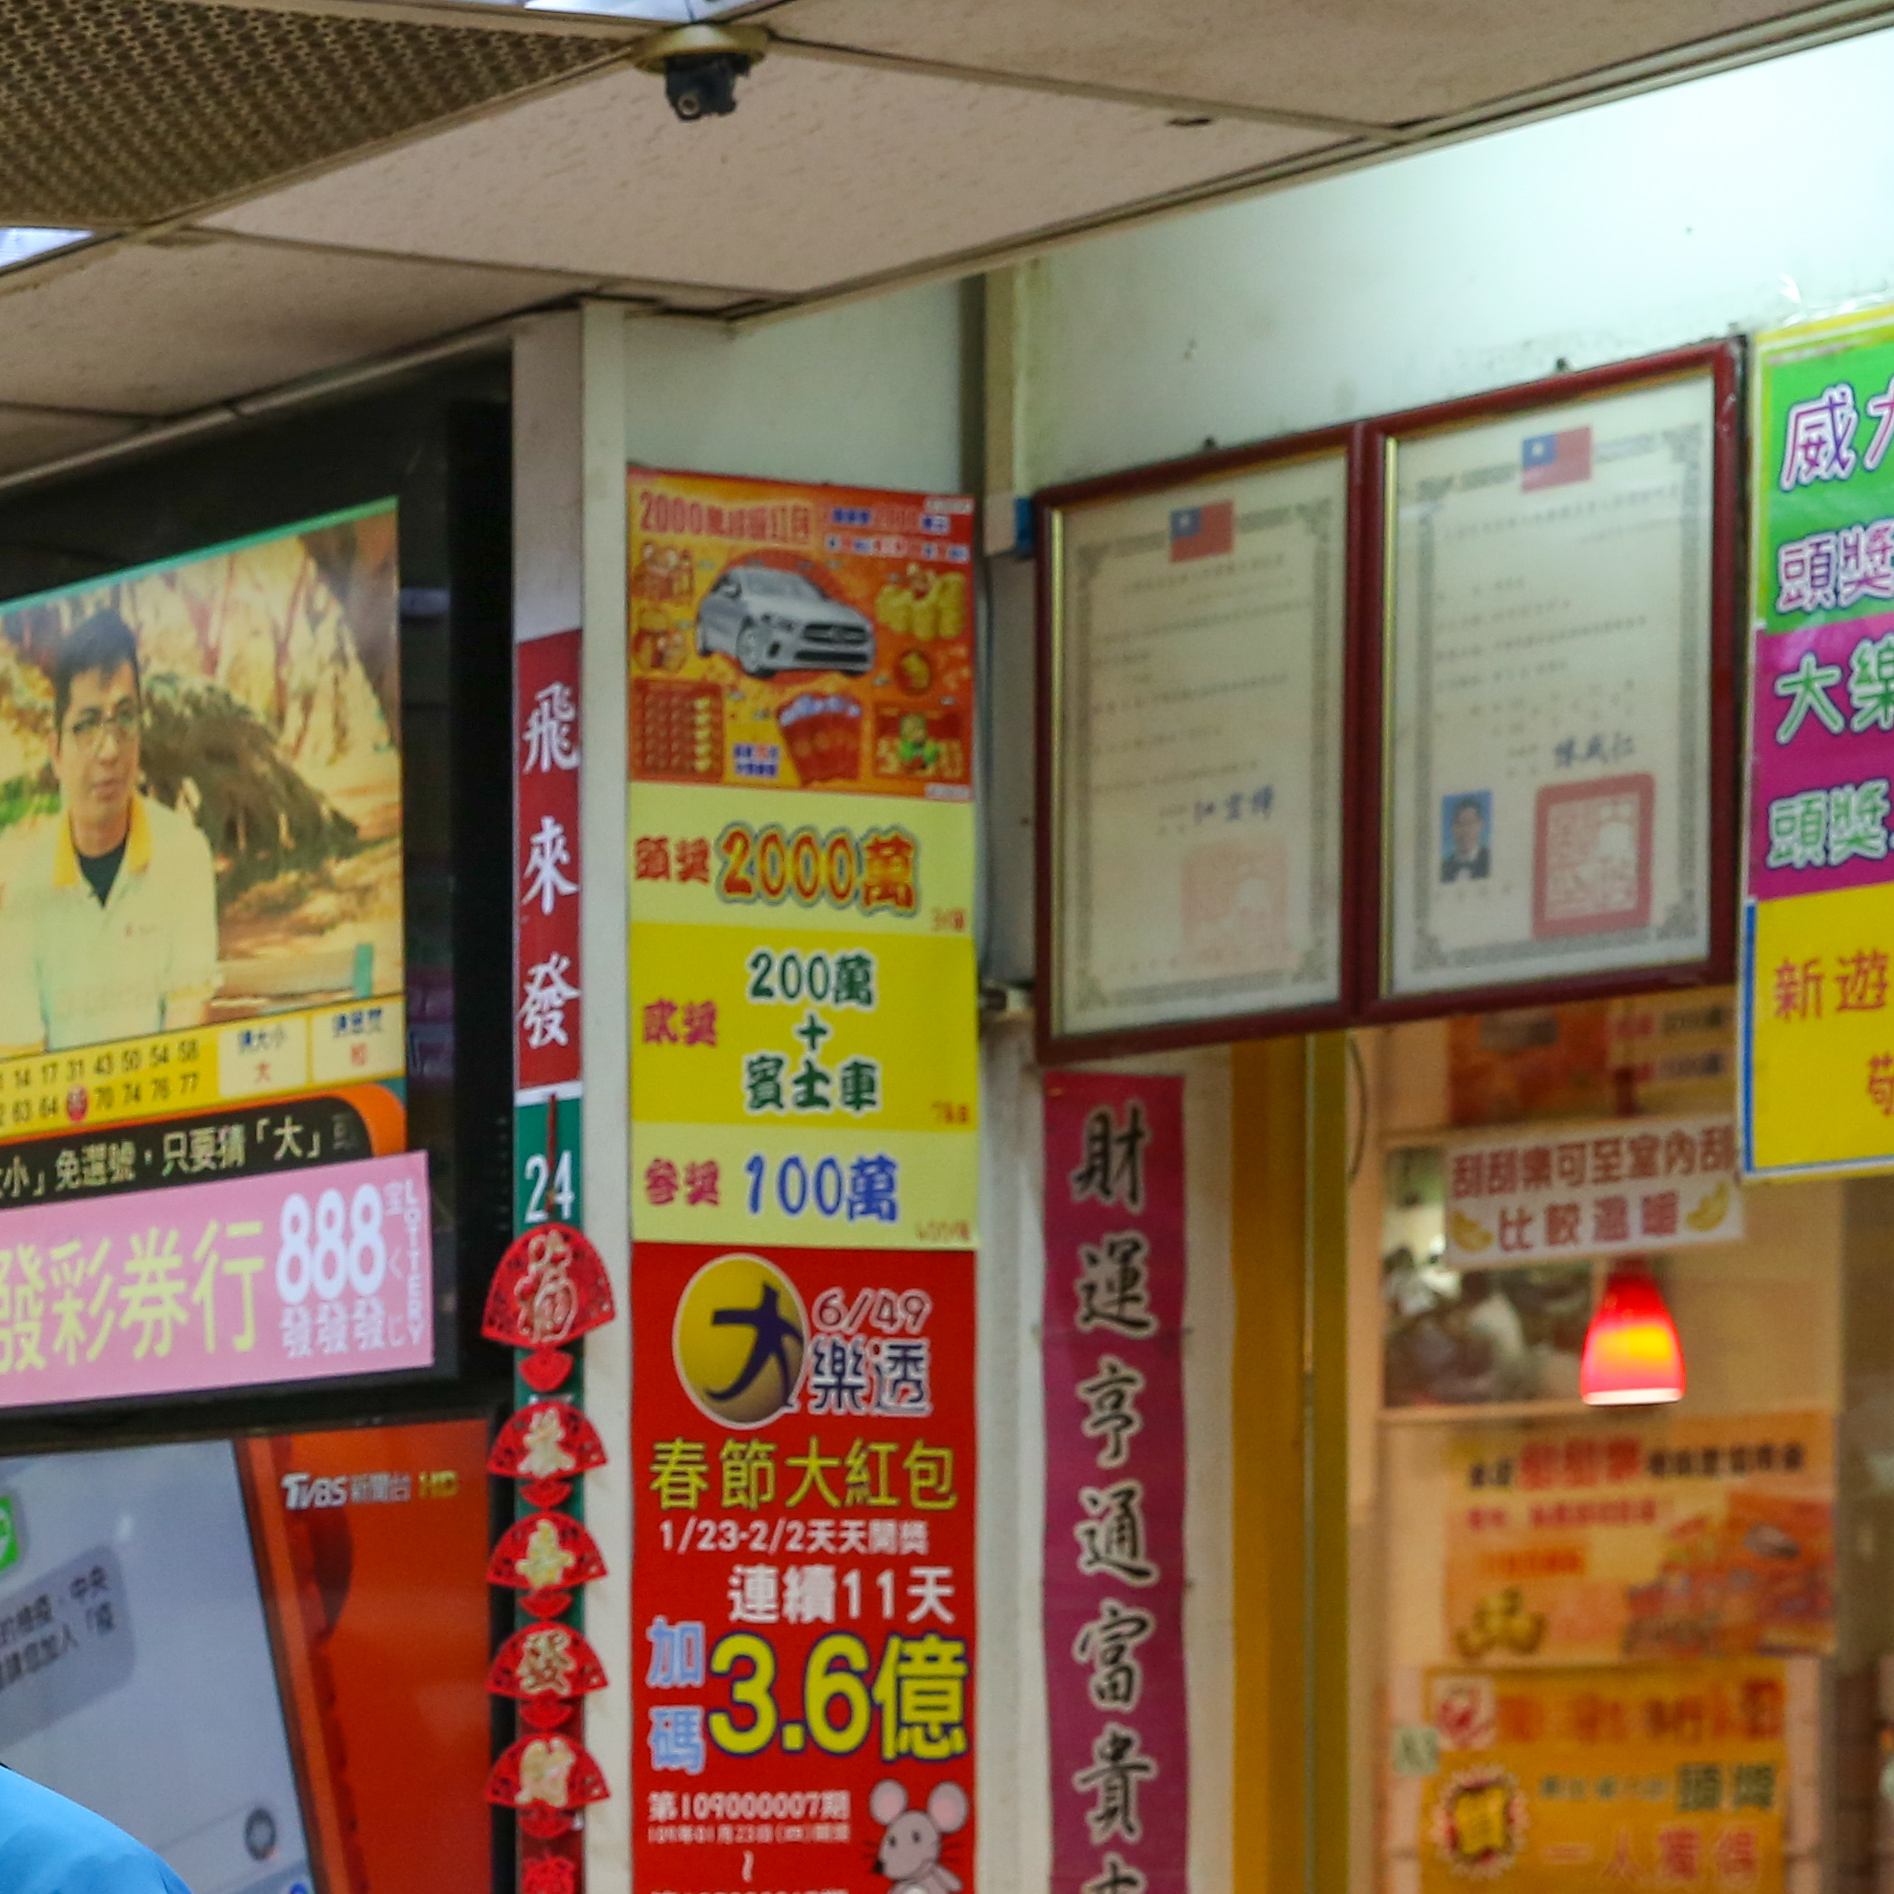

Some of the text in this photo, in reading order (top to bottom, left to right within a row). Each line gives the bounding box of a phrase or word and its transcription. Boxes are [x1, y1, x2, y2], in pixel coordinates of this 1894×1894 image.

[1776, 519, 1894, 613] 頭獎
[1767, 780, 1889, 870] 頭獎
[524, 680, 579, 1050] 飛來發
[634, 827, 917, 913] 頭獎 2000萬
[747, 950, 875, 1006] 200萬
[1772, 950, 1889, 1022] 新遊
[745, 1056, 880, 1113] 賓士車
[745, 1154, 898, 1222] 100萬
[1452, 1129, 1734, 1196] 刮刮樂可至室內刮
[275, 1183, 386, 1304] 888
[1497, 1190, 1681, 1254] 比較溫暖
[813, 1289, 930, 1335] 6/49
[282, 1473, 347, 1509] TVBS
[648, 1438, 958, 1511] 春節大紅包
[659, 1519, 929, 1556] 1/23-2/2天天開獎
[728, 1565, 956, 1625] 連續11天
[647, 1618, 706, 1774] 加碼
[708, 1632, 968, 1761] 3.6億
[648, 1790, 850, 1821] 第109000007期
